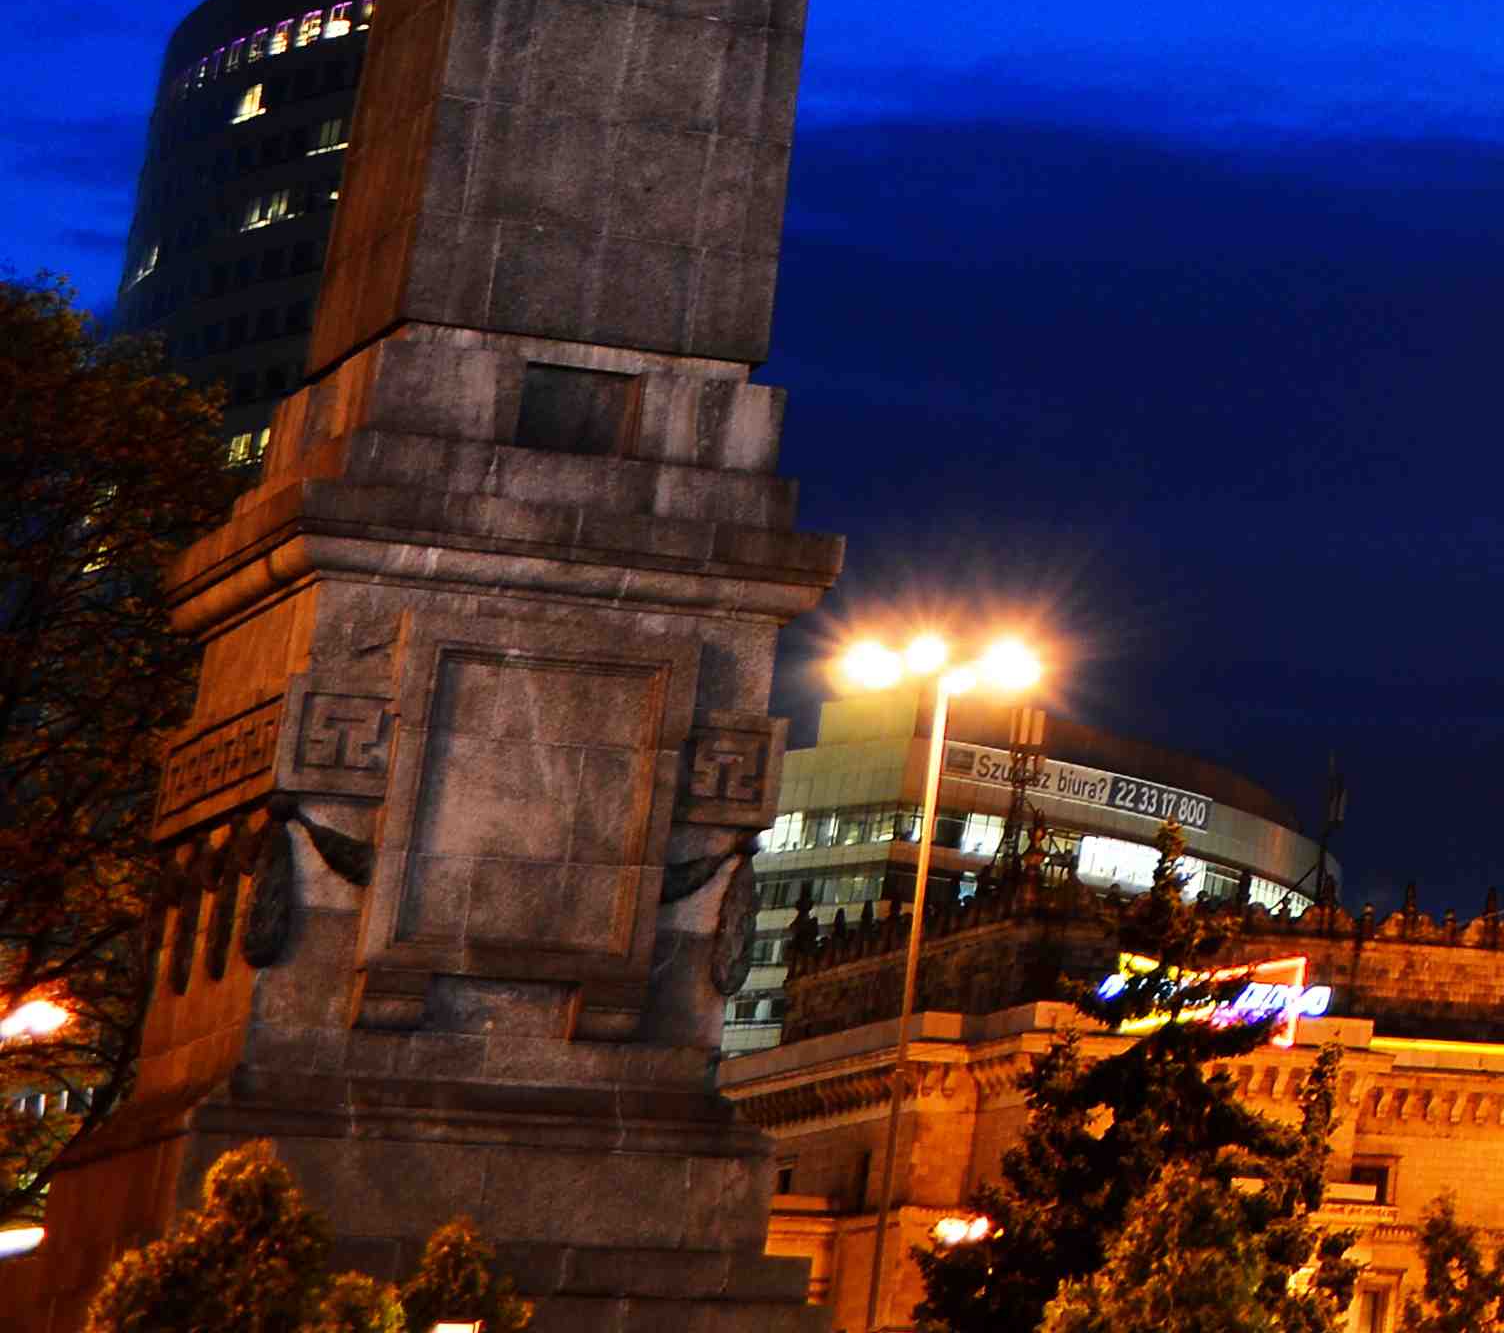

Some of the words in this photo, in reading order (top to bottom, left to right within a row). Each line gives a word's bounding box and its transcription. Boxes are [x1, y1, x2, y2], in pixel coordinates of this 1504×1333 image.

[977, 754, 1051, 789] Szuasz
[1057, 770, 1107, 800] biura?
[1116, 781, 1137, 808] 22
[1139, 786, 1158, 813] 33
[1162, 793, 1177, 817] 17
[1178, 796, 1206, 826] 800
